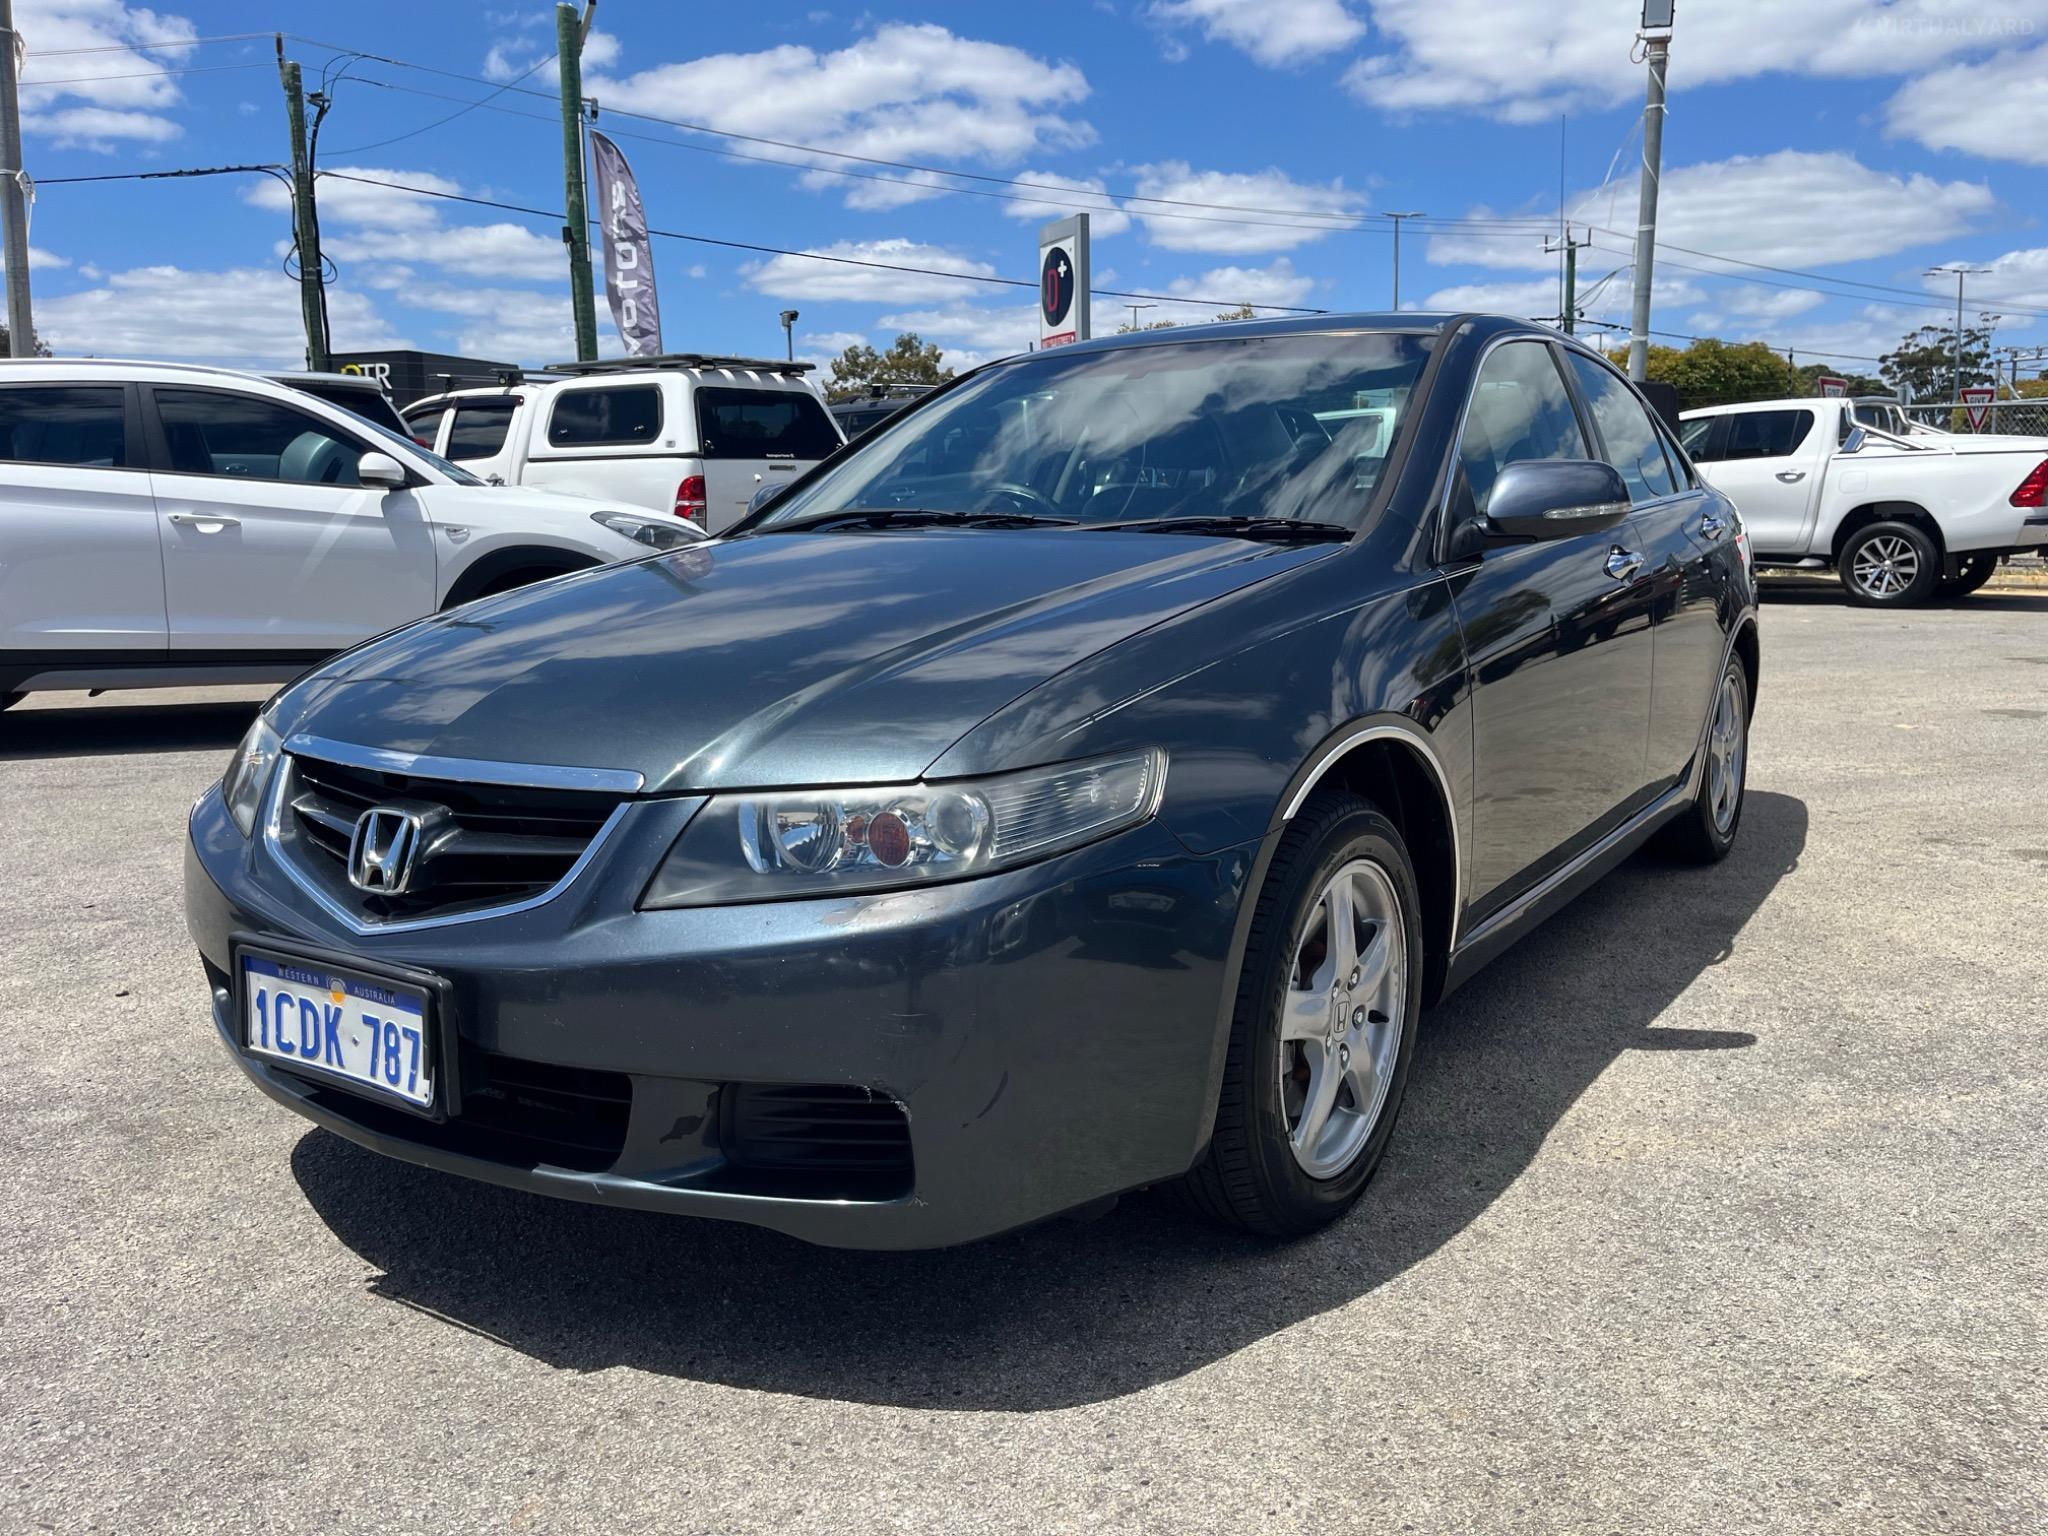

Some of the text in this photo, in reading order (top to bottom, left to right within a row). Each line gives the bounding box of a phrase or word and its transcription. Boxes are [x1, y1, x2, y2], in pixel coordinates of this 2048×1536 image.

[277, 967, 396, 1006] WESTERN AUSTRALIA
[256, 987, 421, 1094] 1CDK 787
